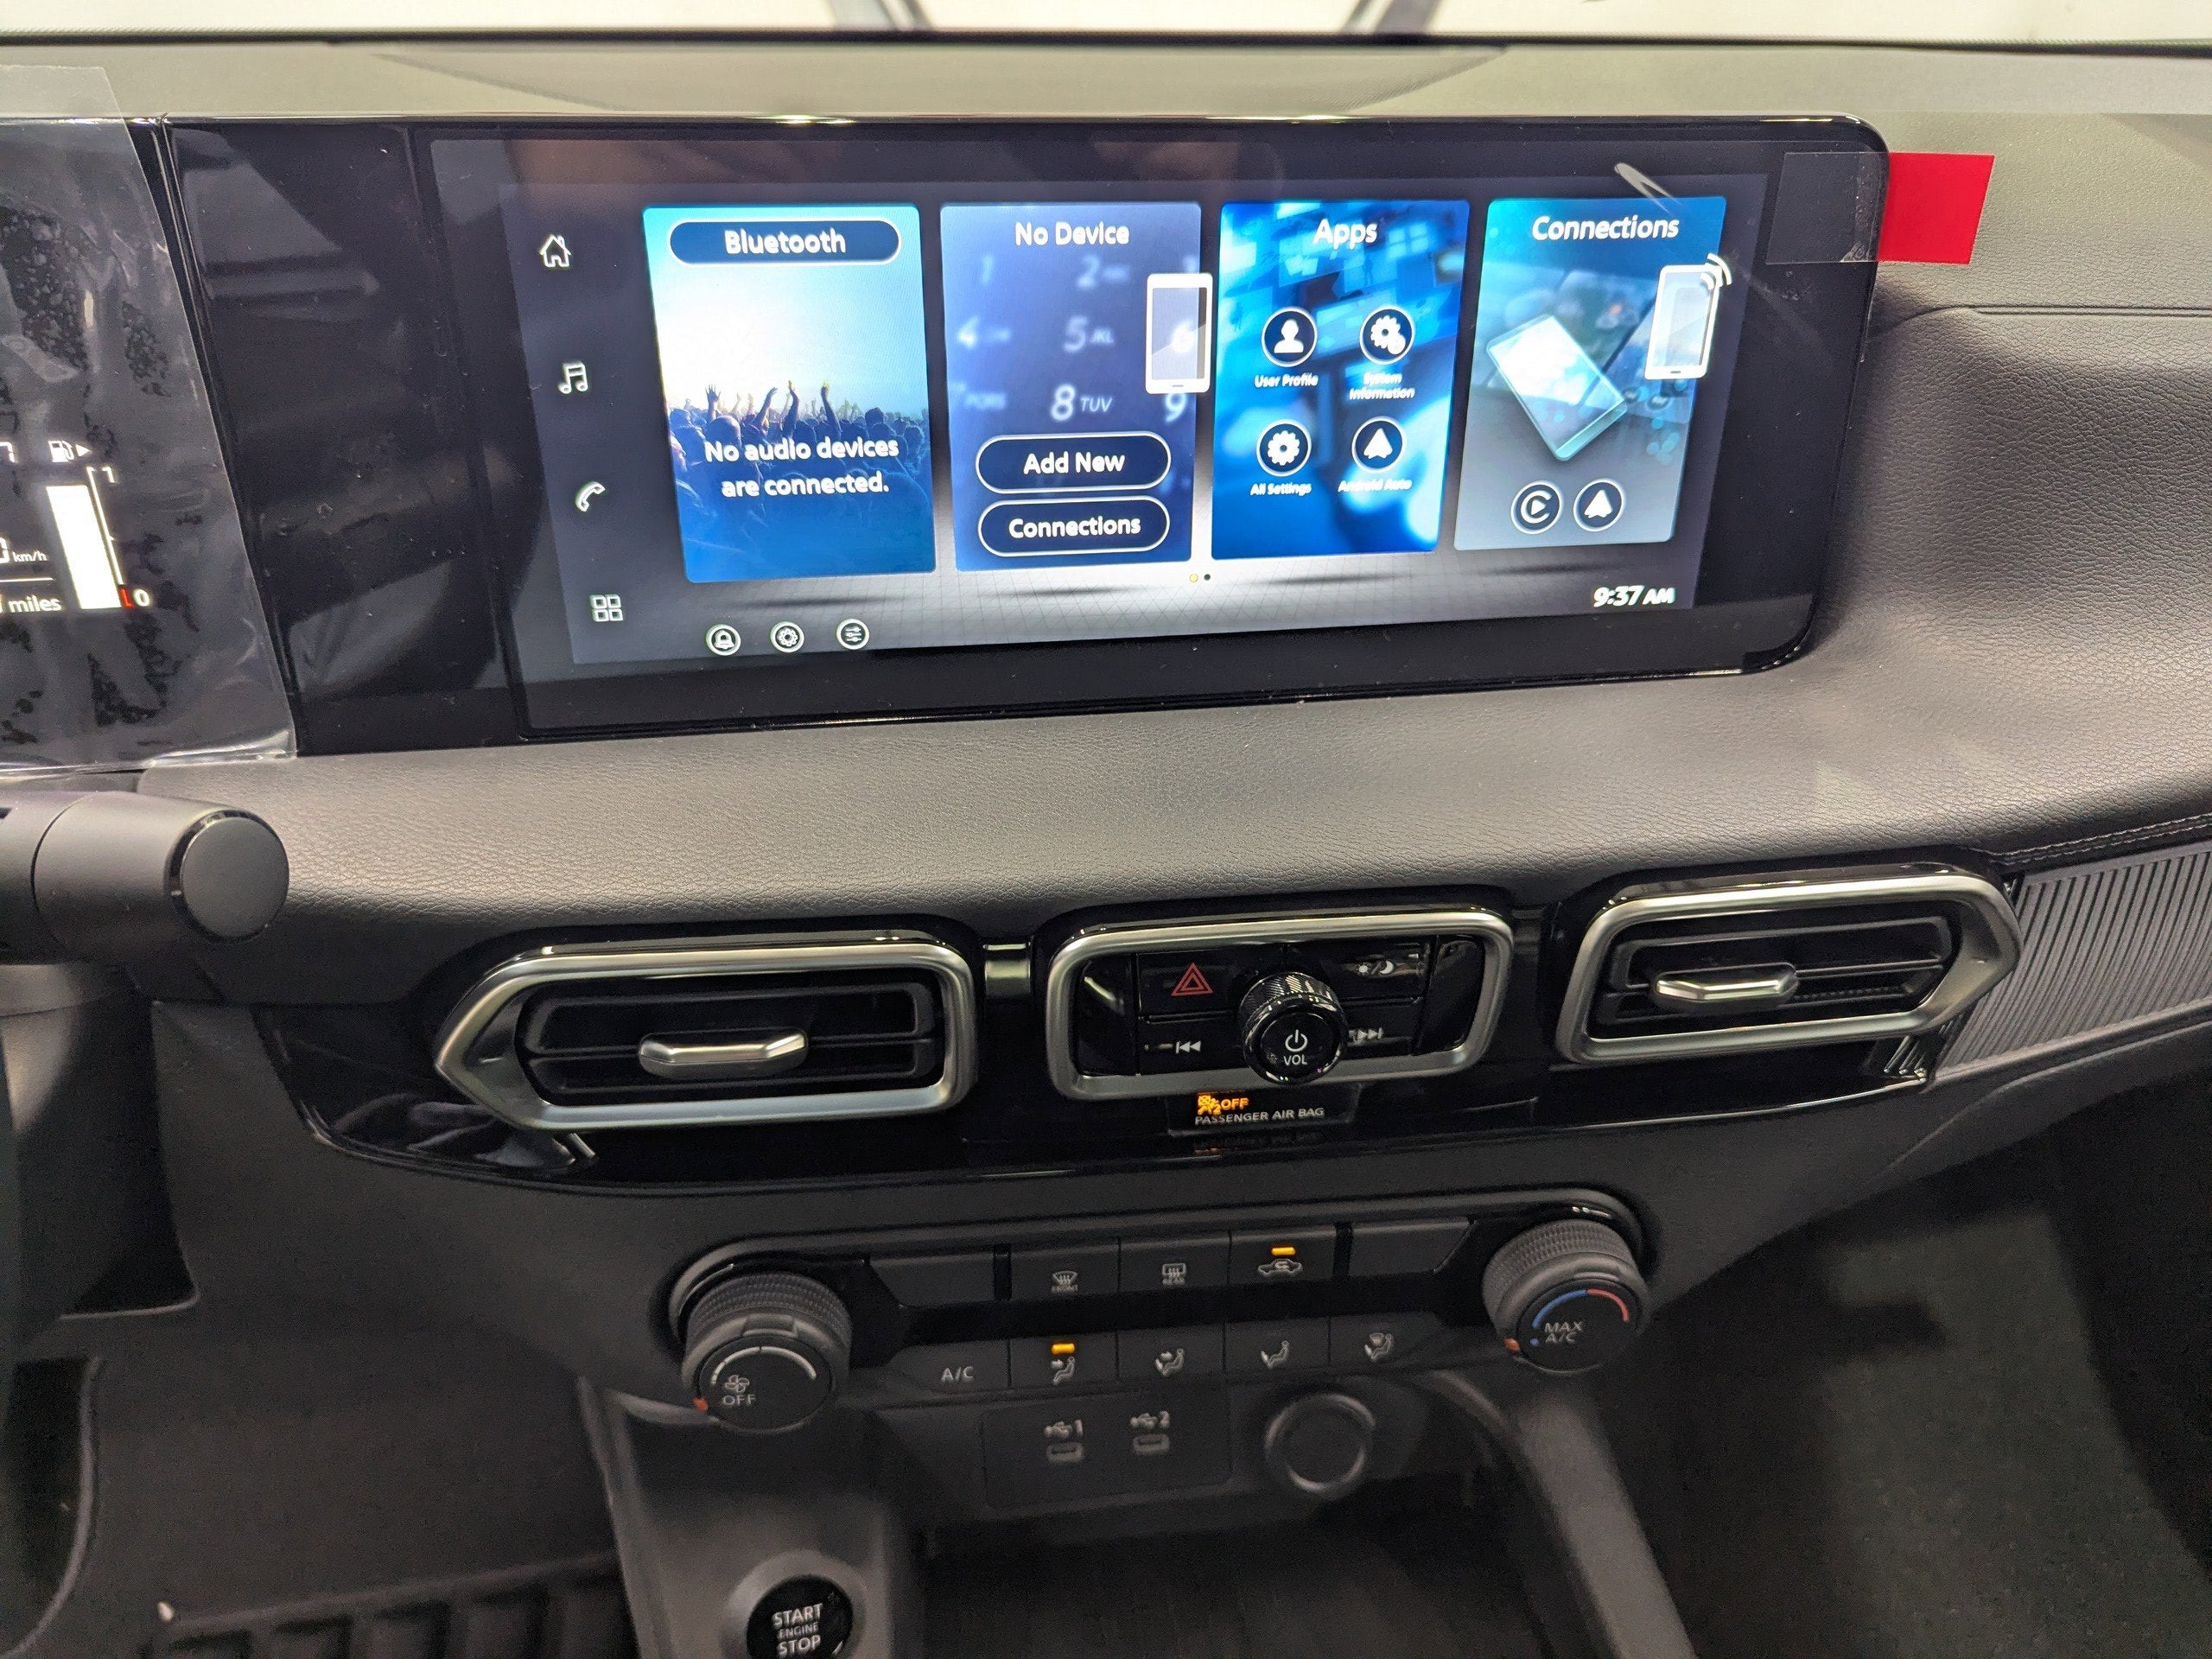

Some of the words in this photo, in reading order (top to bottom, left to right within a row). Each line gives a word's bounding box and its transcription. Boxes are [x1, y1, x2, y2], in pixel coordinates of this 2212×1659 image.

[1014, 221, 1049, 246] No
[1055, 221, 1130, 245] Device
[1312, 218, 1378, 250] Apps
[1532, 214, 1680, 241] Connections
[723, 227, 846, 254] Bluetooth
[1064, 315, 1090, 353] 5
[1255, 375, 1280, 388] User
[1282, 372, 1319, 387] Profile
[1051, 384, 1076, 422] 8
[1080, 397, 1113, 413] TUV
[704, 441, 740, 462] No
[744, 437, 811, 461] audio
[817, 435, 899, 459] devices
[1023, 451, 1069, 475] Add
[1075, 451, 1126, 474] New
[102, 466, 116, 484] 1
[721, 479, 760, 498] are
[764, 471, 890, 496] connected.
[1384, 477, 1413, 491] Auto
[1249, 483, 1265, 496] All
[1268, 482, 1312, 497] Settings
[1008, 516, 1141, 539] Connections
[12, 550, 48, 563] km/h
[8, 594, 62, 613] miles
[133, 588, 150, 607] 0
[1593, 584, 1644, 607] 9:37
[1643, 587, 1676, 606] AM
[1283, 1054, 1308, 1066] VOL
[1220, 1097, 1249, 1110] OFF
[1194, 1111, 1269, 1125] PASSENGER
[1272, 1109, 1295, 1120] AIR
[1298, 1107, 1325, 1118] BAG
[1544, 1320, 1583, 1332] MAX
[1545, 1332, 1578, 1344] A/C
[941, 1365, 975, 1382] A/C
[722, 1394, 756, 1407] OFF
[771, 1602, 823, 1630] START
[778, 1621, 820, 1639] ENGINE
[777, 1634, 822, 1659] STOP
